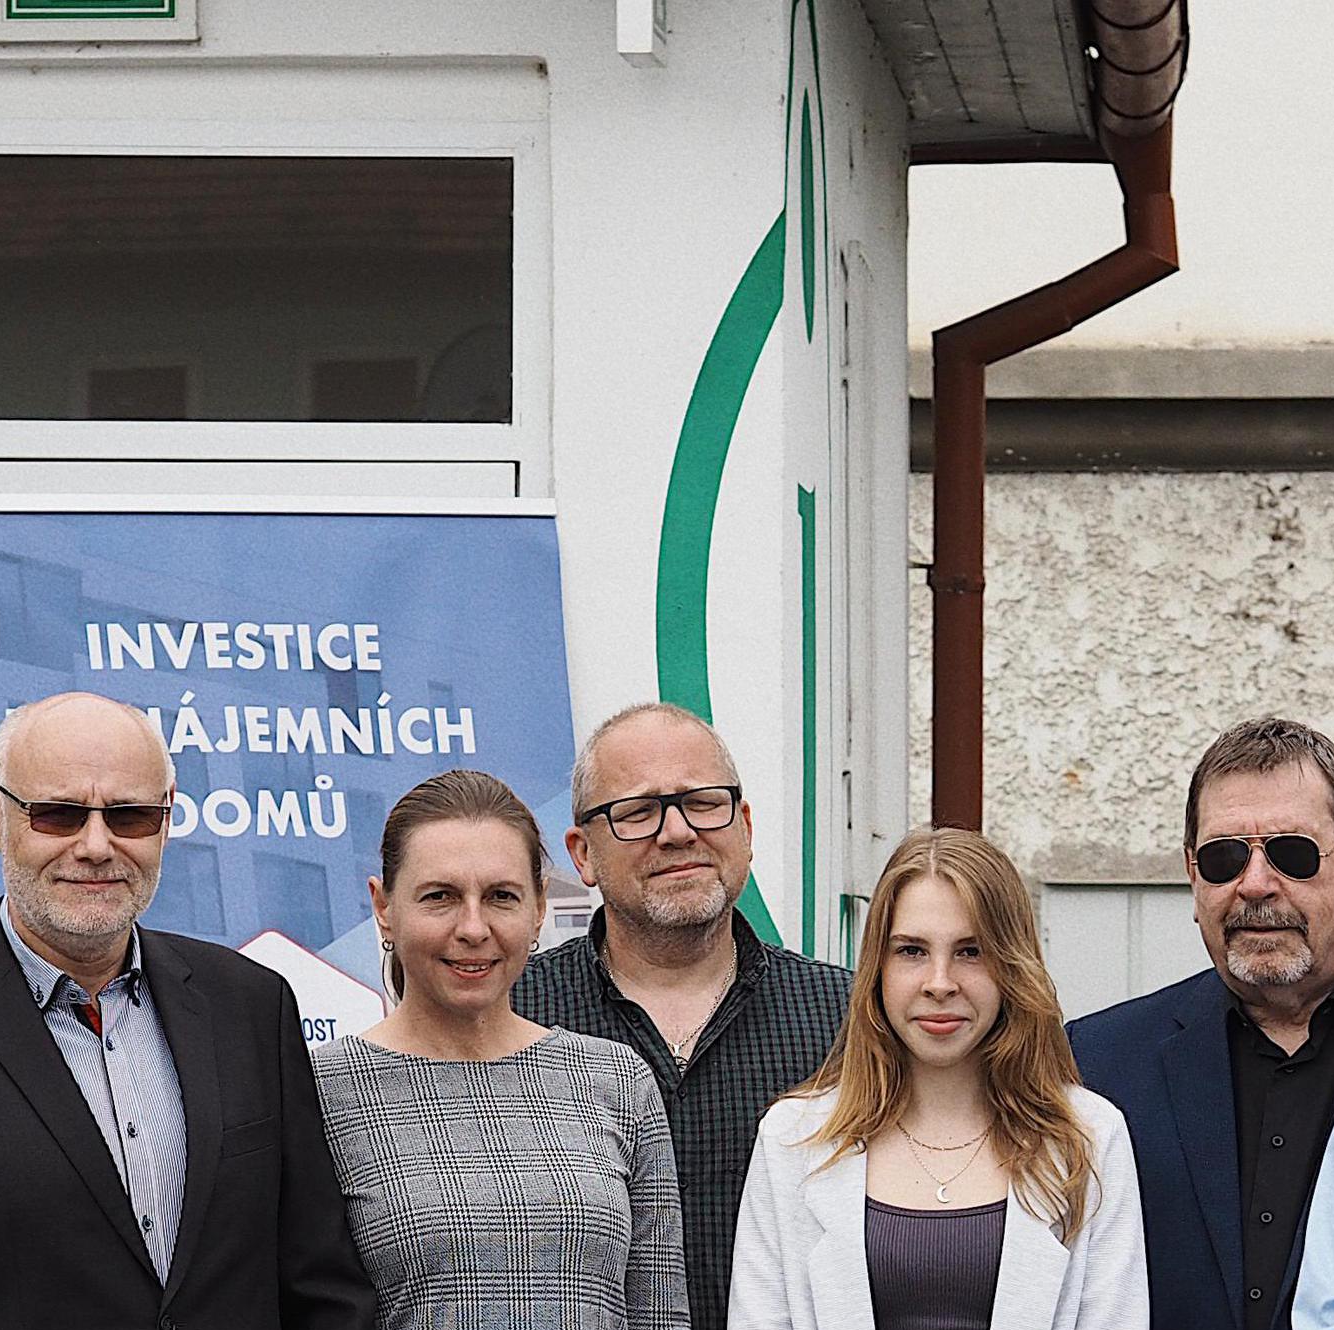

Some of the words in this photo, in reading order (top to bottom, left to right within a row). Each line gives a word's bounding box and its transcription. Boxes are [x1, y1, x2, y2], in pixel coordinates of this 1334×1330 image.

[86, 622, 382, 671] INVESTICE
[148, 690, 476, 754] ÁJEMNÍCH
[168, 774, 347, 838] DOMŮ
